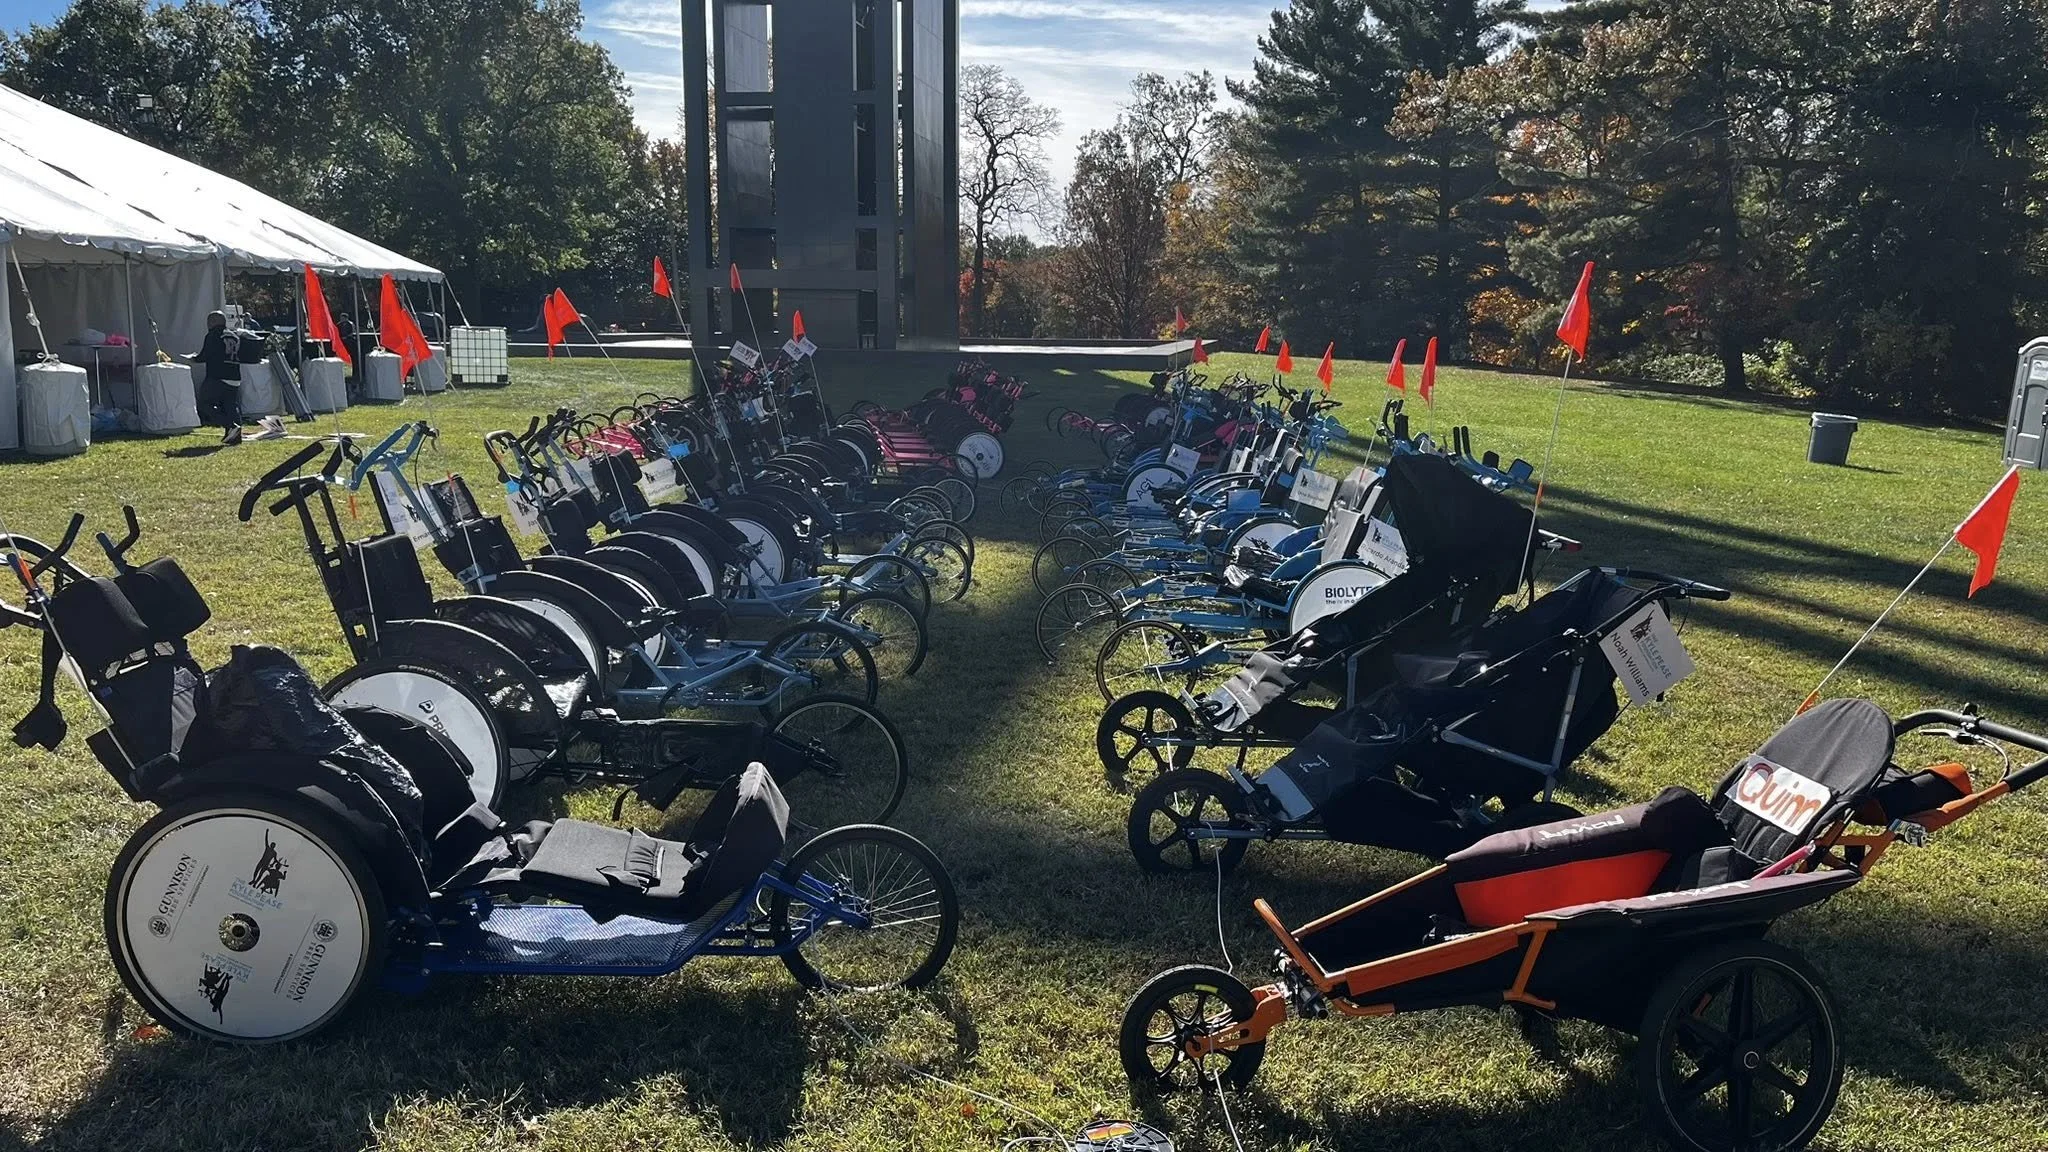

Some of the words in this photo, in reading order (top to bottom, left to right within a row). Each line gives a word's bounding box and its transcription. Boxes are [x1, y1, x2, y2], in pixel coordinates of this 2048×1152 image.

[1136, 477, 1154, 500] AG1
[1611, 632, 1628, 658] Noah
[1625, 656, 1650, 697] Williams
[1644, 636, 1659, 656] KYLE
[1655, 655, 1672, 679] PEASE
[1739, 762, 1821, 831] Quinn
[157, 853, 192, 915] GUNNISON
[167, 898, 180, 917] TREE
[176, 859, 198, 896] SERVICES
[232, 881, 255, 897] KYLE
[255, 892, 283, 910] PEASE
[293, 943, 327, 1003] GUNNISON
[303, 942, 316, 961] TREE
[286, 963, 306, 999] SERVICES
